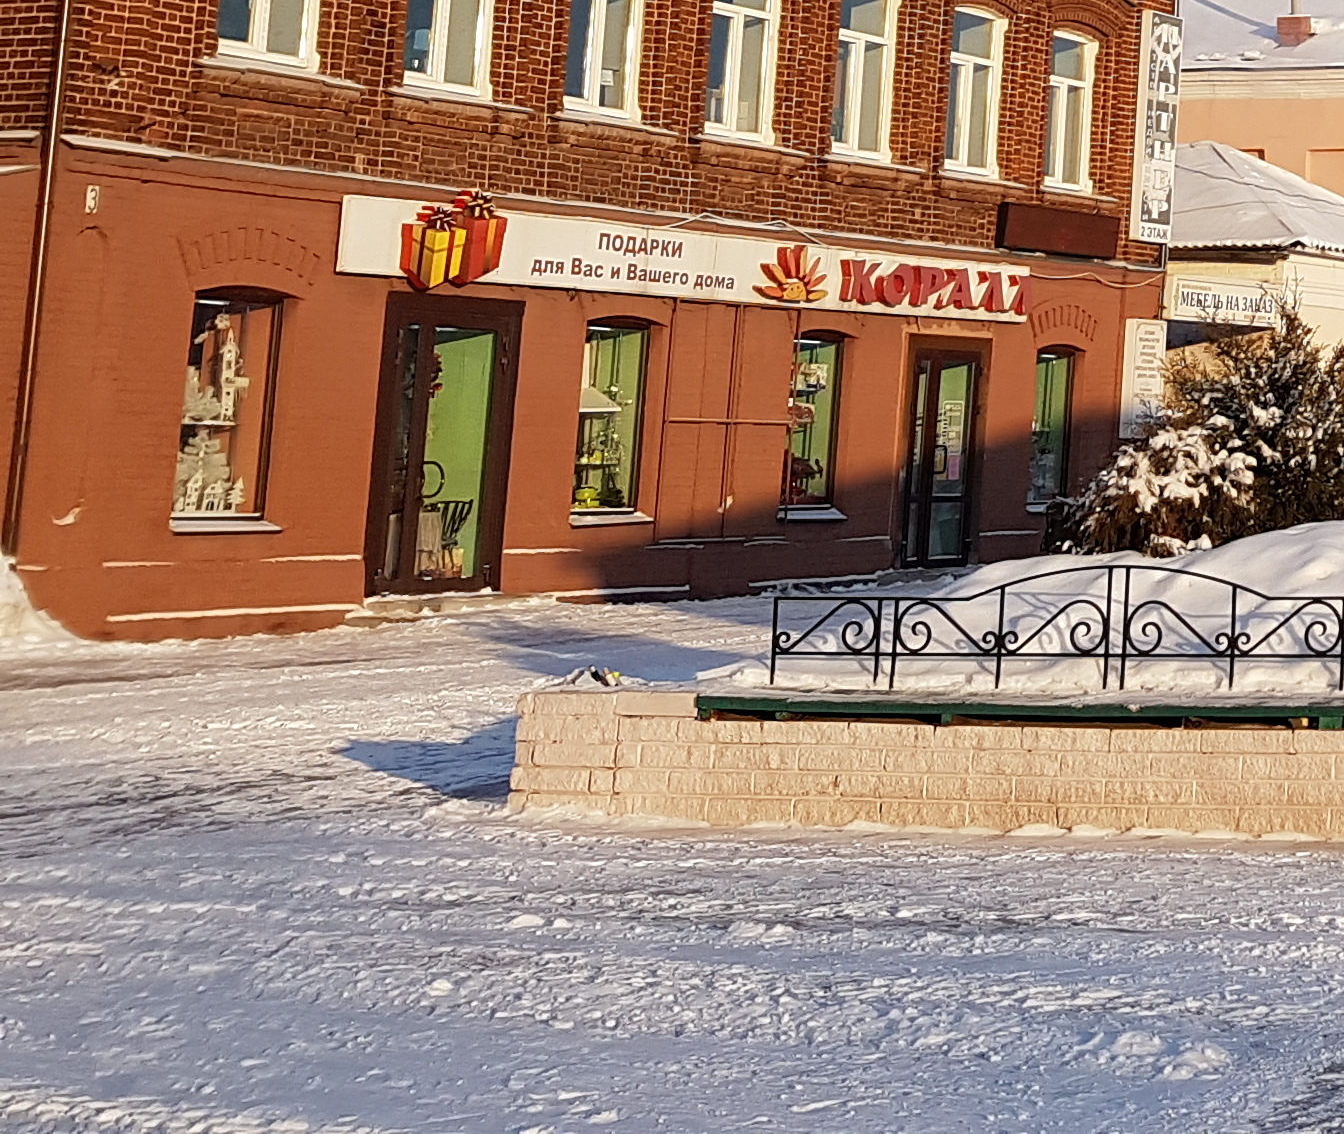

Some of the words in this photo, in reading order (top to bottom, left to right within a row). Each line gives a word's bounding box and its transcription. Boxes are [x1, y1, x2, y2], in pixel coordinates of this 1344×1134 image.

[1152, 23, 1179, 219] ПАРТНЕР
[598, 232, 683, 258] ПОДАРКИ
[1140, 225, 1146, 237] 2
[1146, 227, 1170, 241] ЭТАЖ
[531, 259, 565, 277] для
[571, 257, 604, 278] Вас
[610, 266, 621, 280] и
[626, 263, 689, 286] Вашего
[693, 274, 735, 290] дома
[839, 259, 1032, 314] КОРАЛЛ
[1180, 290, 1224, 310] МЕБЕЛЬ
[1225, 294, 1240, 312] НА
[1241, 296, 1273, 315] ЗАКАЗ
